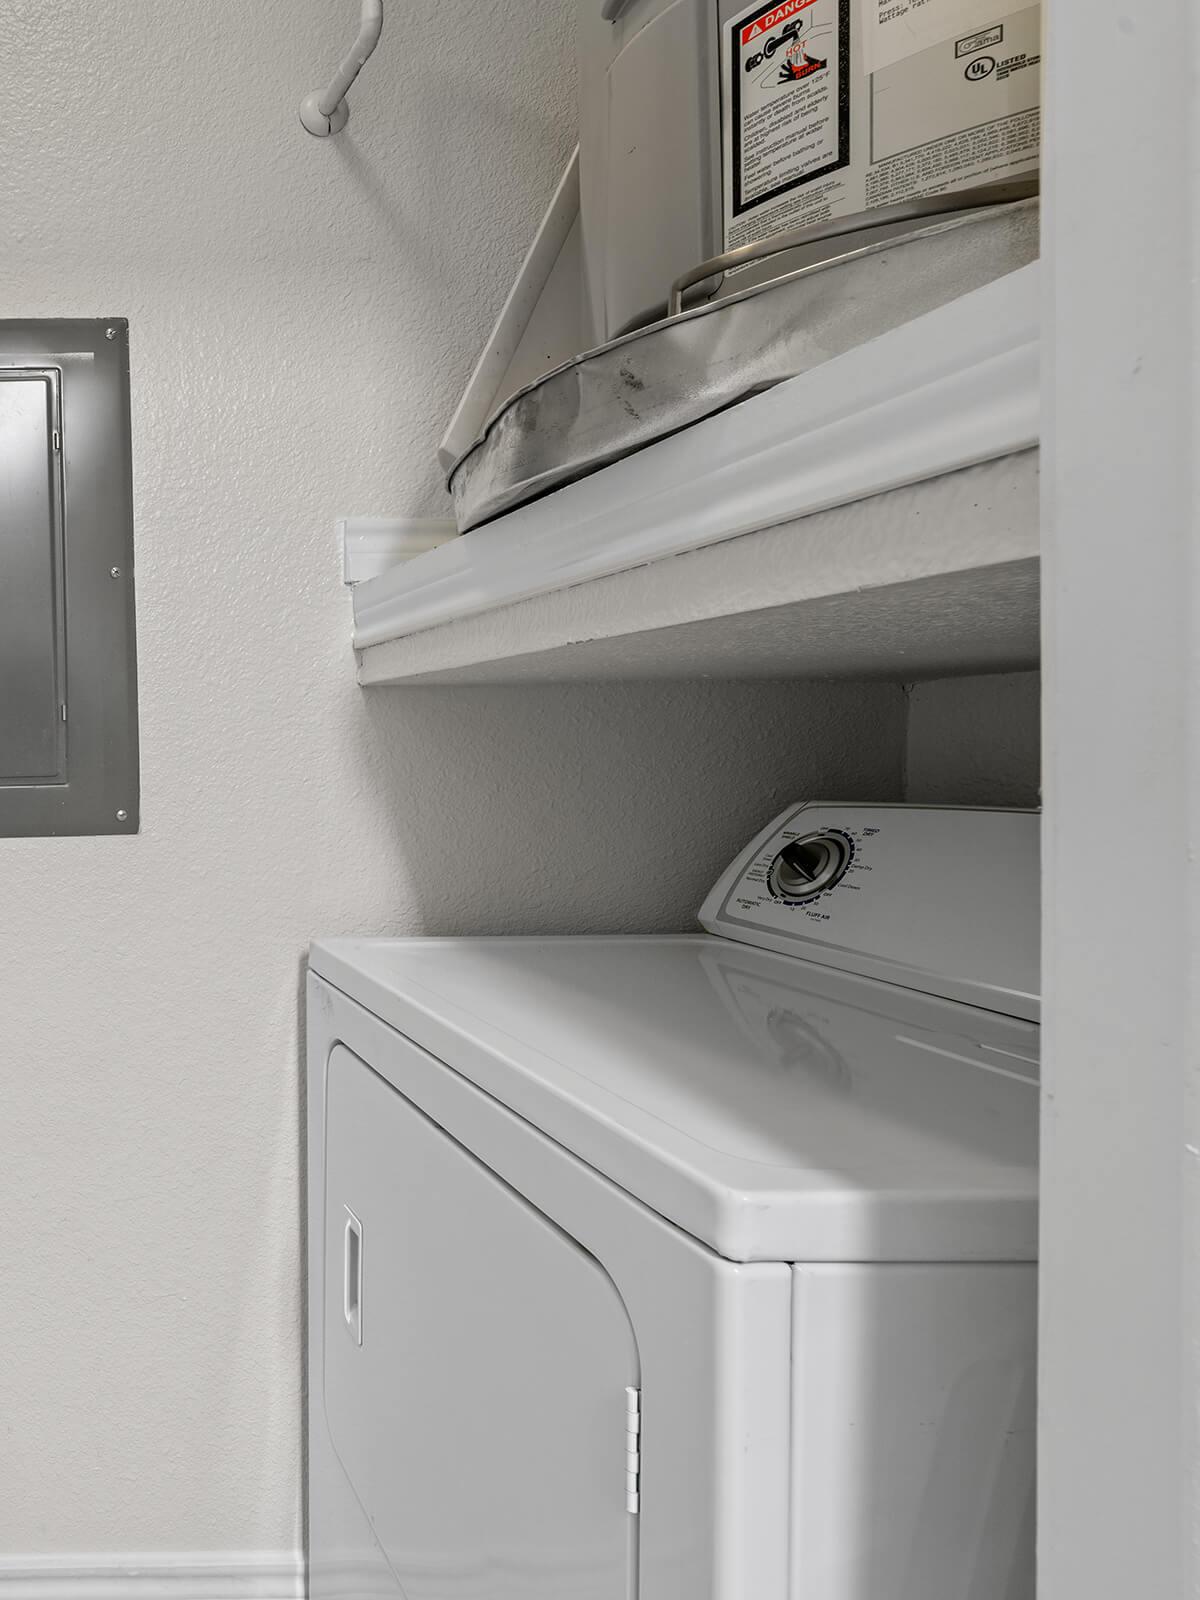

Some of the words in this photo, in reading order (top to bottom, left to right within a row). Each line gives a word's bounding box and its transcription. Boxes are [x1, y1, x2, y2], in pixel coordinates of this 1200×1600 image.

[765, 0, 811, 28] DANG
[879, 7, 909, 24] Wattage
[785, 40, 808, 58] HOT
[971, 62, 988, 74] UL
[996, 54, 1027, 68] LISTED
[795, 63, 821, 79] BURN
[760, 90, 795, 112] temperature
[805, 911, 821, 919] FLUFF
[820, 913, 831, 921] AIR
